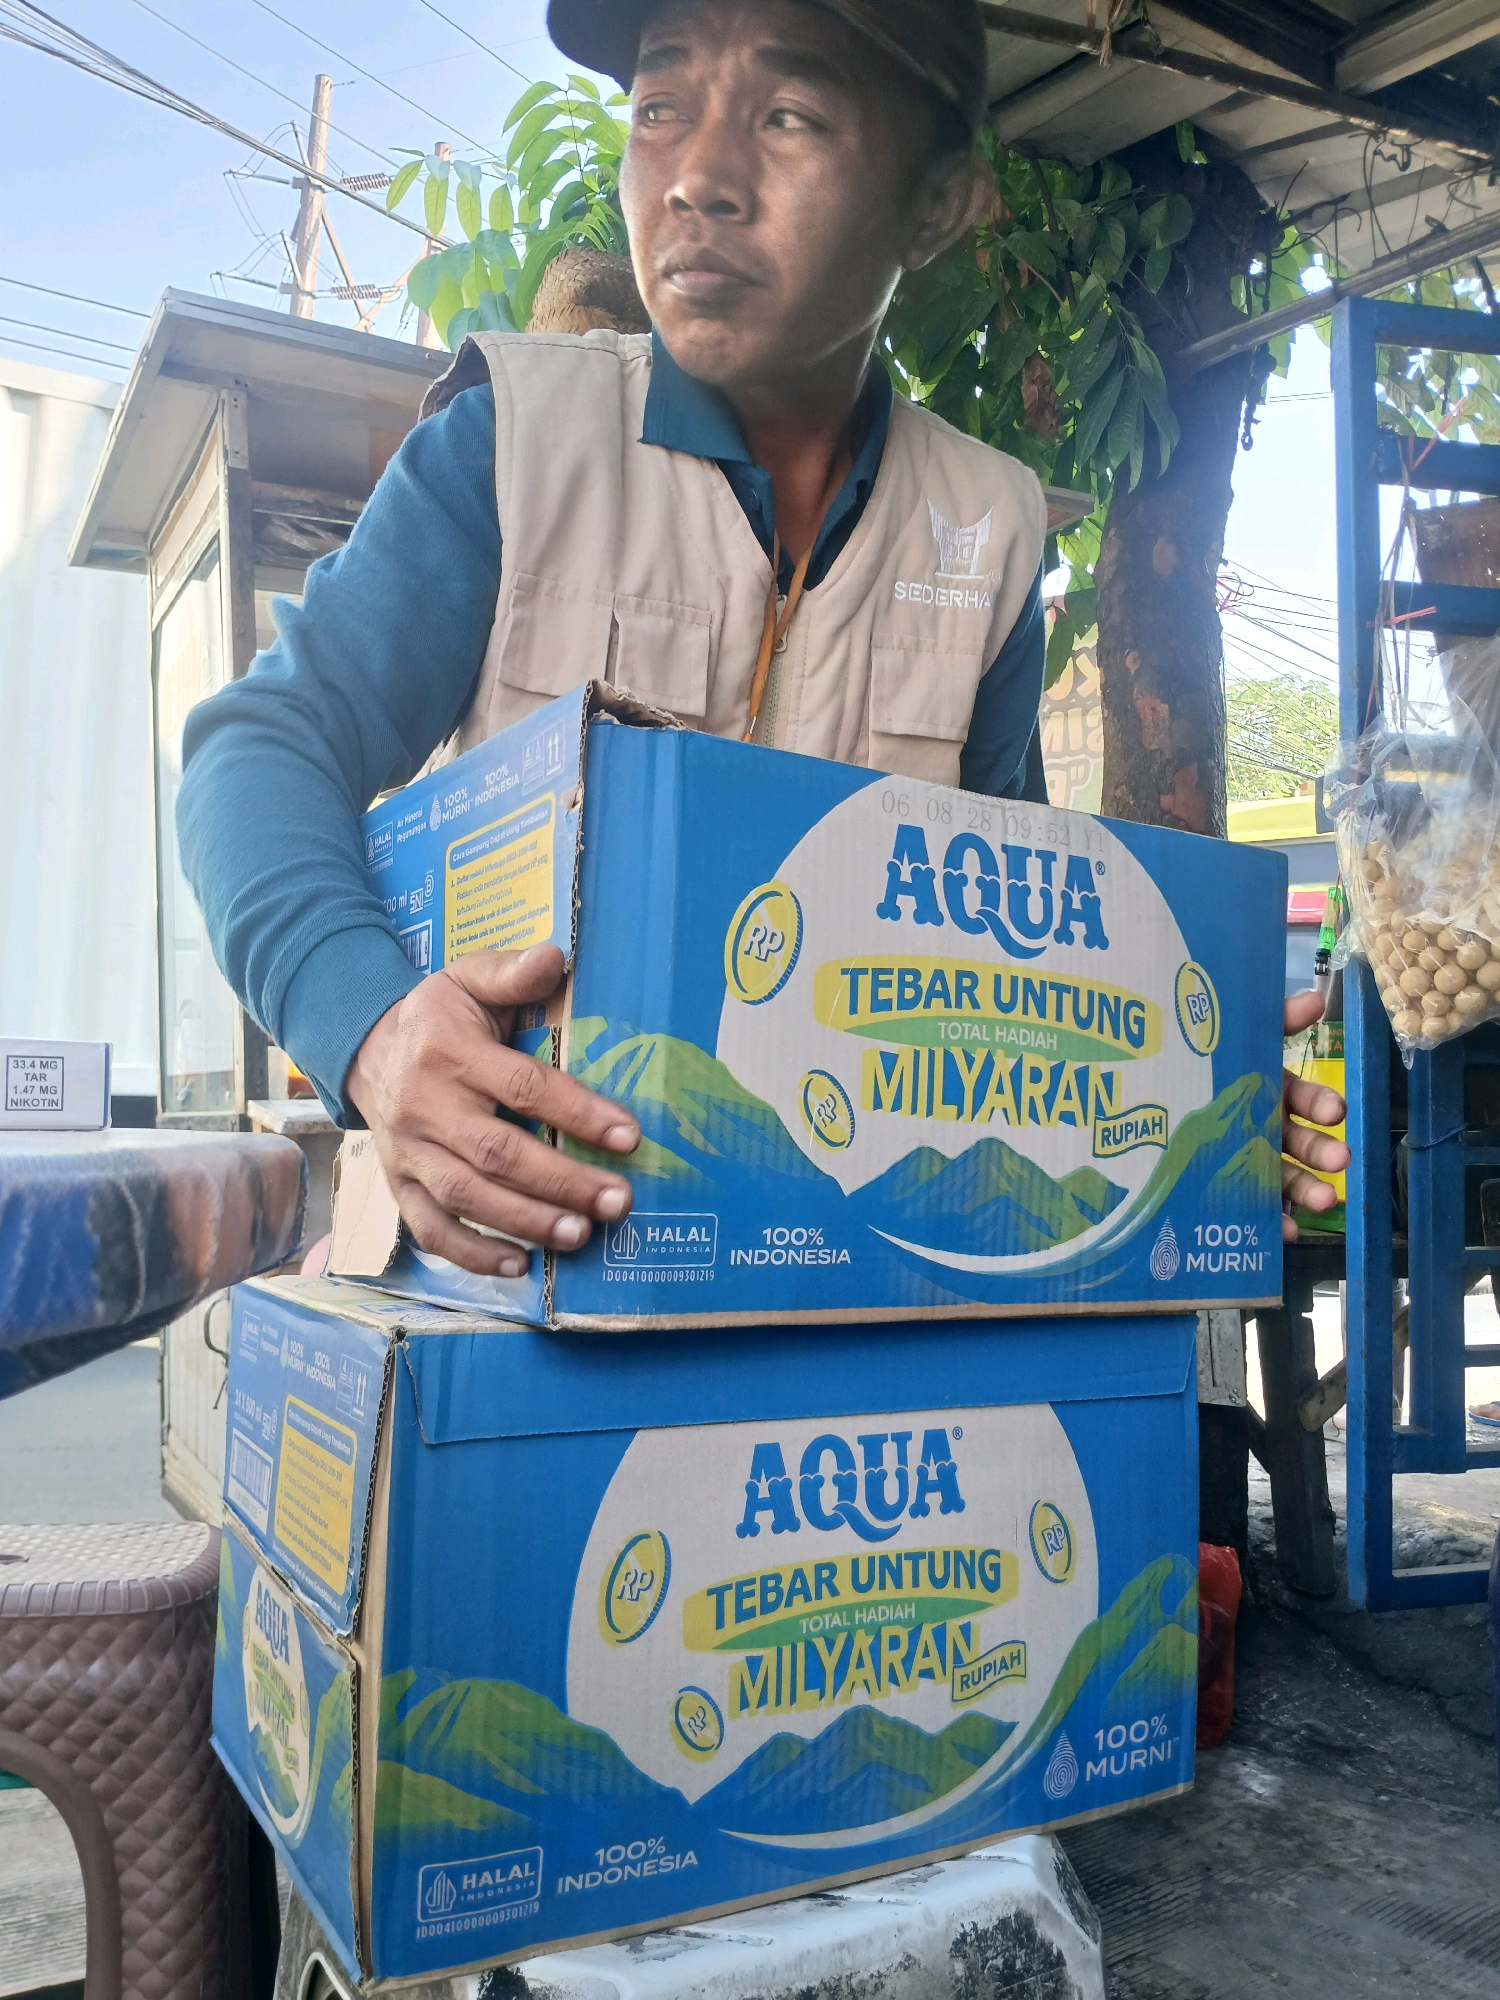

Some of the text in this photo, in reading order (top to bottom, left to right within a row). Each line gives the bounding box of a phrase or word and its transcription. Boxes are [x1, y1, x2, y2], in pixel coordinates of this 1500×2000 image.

[485, 760, 509, 787] 100%
[444, 787, 468, 808] 100%
[475, 773, 519, 806] INDONESIA
[404, 807, 423, 826] Mineral
[882, 790, 910, 816] 06
[926, 799, 952, 824] 08
[967, 807, 992, 832] 28
[1005, 815, 1070, 846] 09:52
[375, 831, 391, 848] HALAL
[453, 850, 465, 862] Cara
[465, 840, 490, 856] Gampang
[490, 831, 505, 845] Dapat
[399, 890, 407, 910] ml
[744, 926, 785, 962] RP
[840, 967, 1145, 1049] TEBAR UNTUNG
[937, 1021, 1057, 1050] TOTAL HADIAH
[13, 1060, 58, 1070] 33.4 MG
[24, 1073, 47, 1081] TAR
[13, 1085, 58, 1094] 1.47 MG
[861, 1046, 1122, 1128] MILYARAN
[10, 1098, 59, 1107] NIKOTIN
[1101, 1116, 1163, 1148] RUPIAH
[646, 1226, 711, 1242] HALAL
[762, 1227, 824, 1246] 100%
[1194, 1224, 1259, 1246] 100%
[645, 1246, 711, 1254] INDONESIA
[730, 1249, 851, 1266] INDONESIA
[306, 1364, 336, 1391] INDONESIA
[707, 1549, 1001, 1631] TEBAR UNTUNG
[800, 1602, 916, 1634] TOTAL HADIAH
[728, 1620, 980, 1720] MILYARAN
[960, 1649, 1021, 1692] RUPIAH
[1094, 1713, 1167, 1751] 100%
[595, 1836, 666, 1866] 100%
[462, 1862, 535, 1890] HALAL
[557, 1851, 699, 1894] INDONESIA
[460, 1880, 535, 1902] INDONESIA
